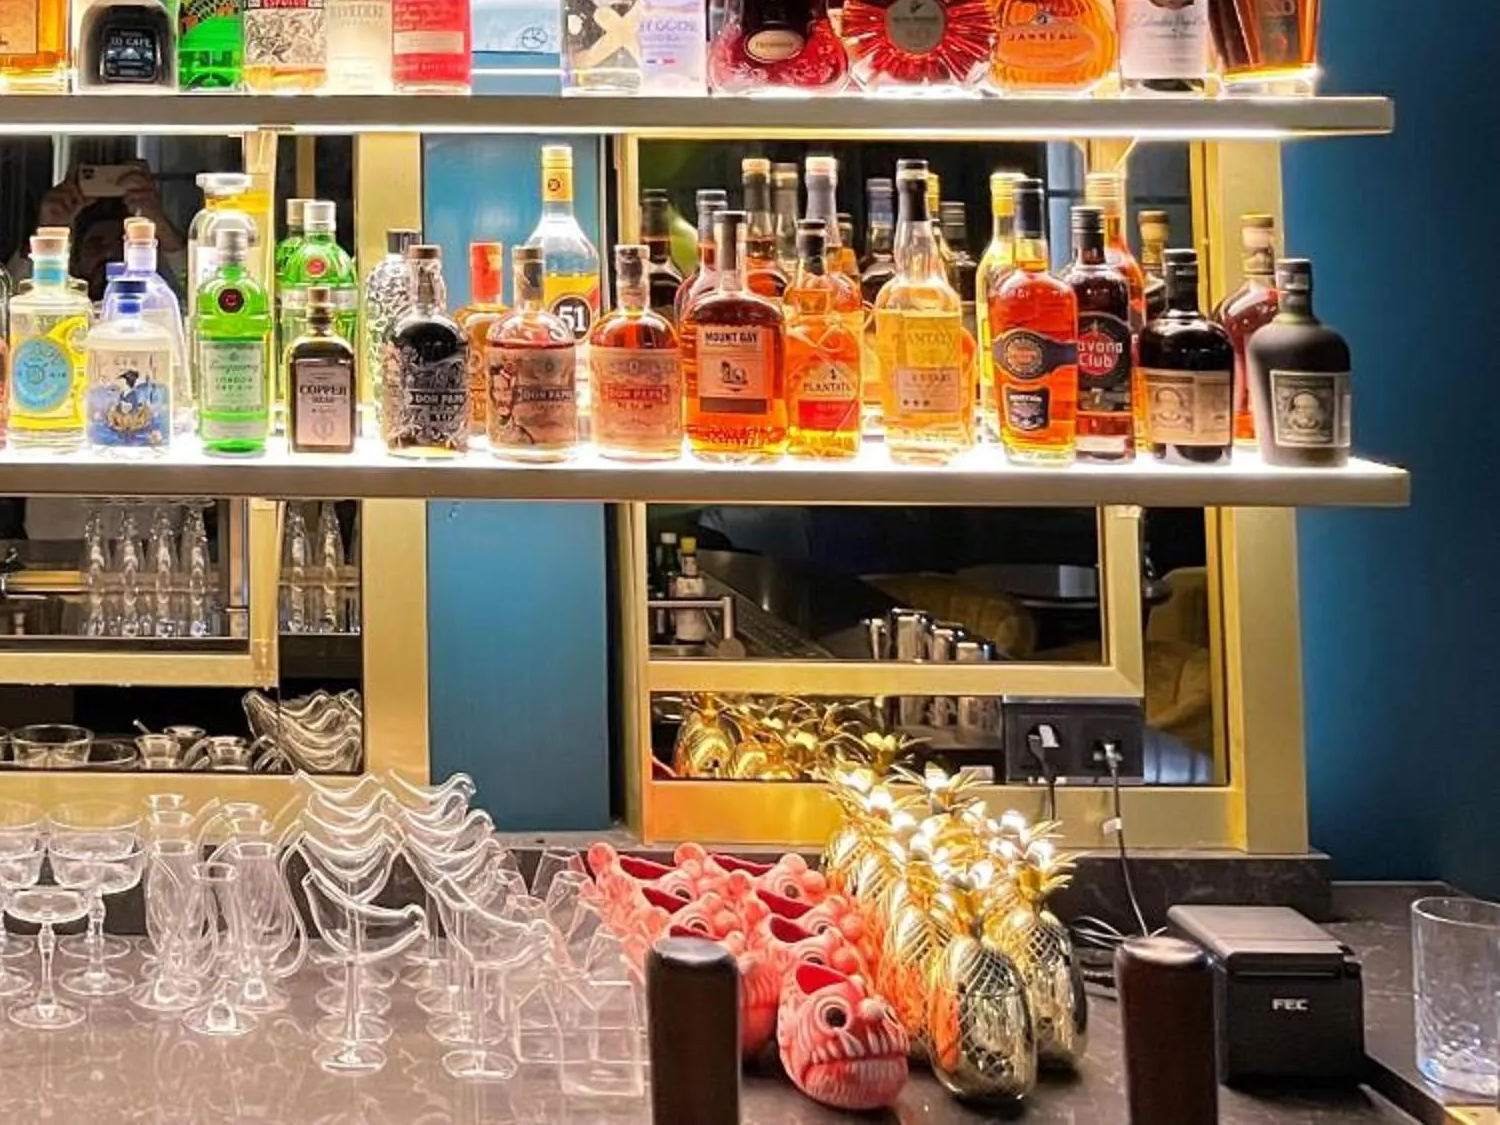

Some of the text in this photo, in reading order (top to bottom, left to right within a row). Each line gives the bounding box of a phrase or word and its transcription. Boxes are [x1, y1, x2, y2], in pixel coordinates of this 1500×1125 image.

[558, 306, 588, 332] 51
[705, 332, 758, 344] MOUNT GAY
[1077, 341, 1123, 356] avana
[1078, 352, 1113, 368] Club
[1271, 997, 1309, 1011] FEC
